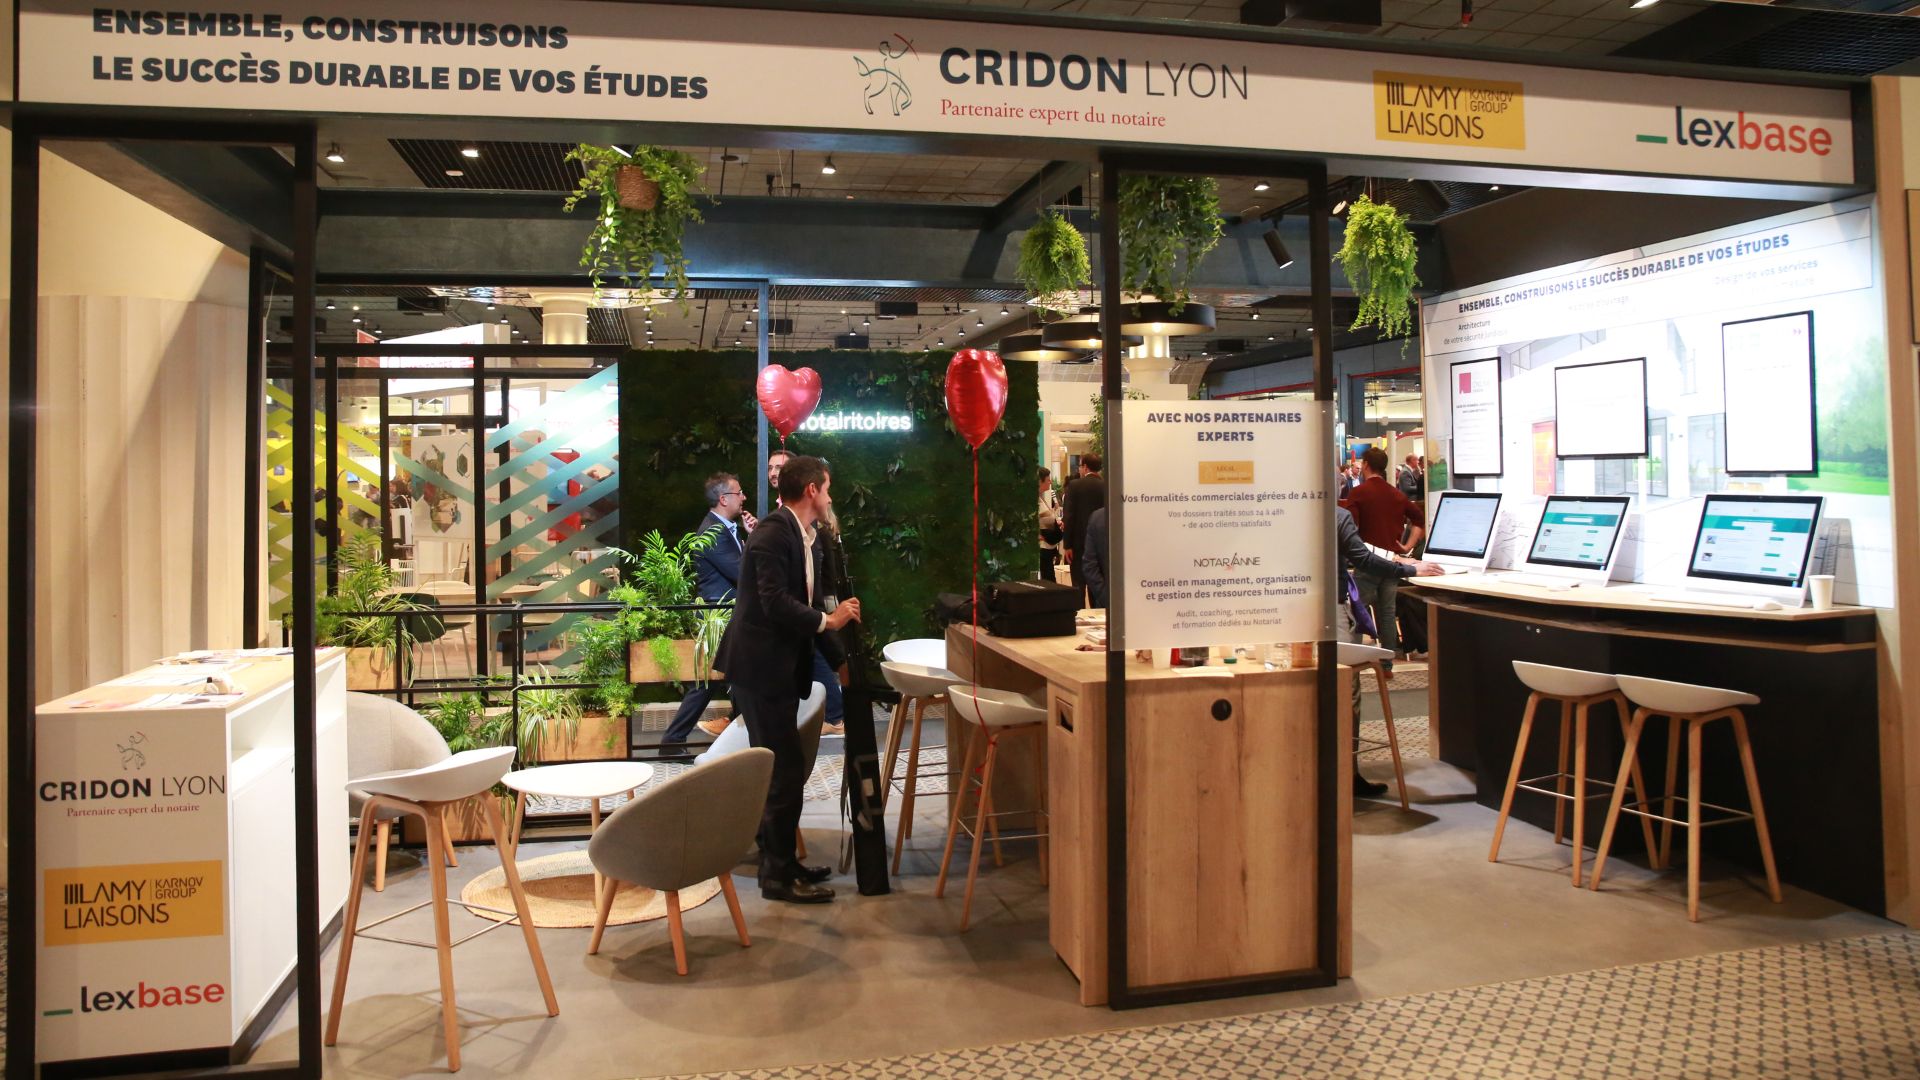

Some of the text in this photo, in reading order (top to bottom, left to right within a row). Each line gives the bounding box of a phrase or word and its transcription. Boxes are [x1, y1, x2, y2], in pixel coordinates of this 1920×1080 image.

[93, 8, 569, 49] ENSEMBLE, CONSTRUISONS
[93, 52, 709, 99] LE SUCCÈS DURABLE DE VOS ÉTUDES
[938, 47, 1249, 100] CRIDON LYON
[1469, 88, 1514, 102] KARNOV
[940, 99, 1166, 127] Partenaire expert du notaire
[1469, 101, 1508, 114] GROUP
[1387, 112, 1485, 140] LIAISONS
[1675, 105, 1833, 156] lexbase
[1458, 295, 1503, 314] ENSEMBLE,
[1504, 280, 1574, 304] CONSTRUISONS
[1576, 278, 1587, 289] LE
[1589, 266, 1630, 286] SUCCÈS
[1631, 256, 1685, 278] DURABLE
[1688, 252, 1704, 266] DE
[1707, 246, 1733, 262] VOS
[1735, 234, 1790, 256] ÉTUDES
[1778, 260, 1818, 274] services
[800, 411, 911, 431] otairitoires
[1147, 413, 1302, 423] AVEC NOS PARTENAIRES
[1197, 432, 1254, 442] EXPERTS
[1121, 494, 1138, 503] Vos
[1141, 493, 1189, 502] formalités
[1191, 492, 1255, 501] commerciales
[1257, 492, 1286, 503] gérées
[1288, 491, 1299, 500] de
[1301, 491, 1308, 499] A
[1168, 510, 1181, 518] Vos
[1183, 509, 1212, 518] dossiers
[1213, 508, 1237, 517] traités
[1238, 509, 1254, 517] sous
[1265, 508, 1270, 516] à
[1188, 521, 1198, 529] de
[1215, 520, 1239, 528] clients
[1240, 519, 1272, 527] satisfaits
[1140, 579, 1175, 588] Conseil
[1191, 577, 1253, 589] management,
[1256, 574, 1312, 586] organisation
[1146, 586, 1307, 602] et gestion des ressources humaines
[1176, 607, 1278, 620] Audit, coaching, recrutement
[1172, 622, 1180, 630] et
[1181, 620, 1217, 629] formation
[1218, 618, 1241, 628] dédiés
[1253, 617, 1282, 626] Notariat
[39, 775, 225, 802] CRIDON LYON
[66, 803, 200, 818] Partenaire expert du notaire
[155, 876, 203, 889] KARNOV
[155, 887, 197, 900] GROUP
[64, 903, 170, 929] LIAISONS
[80, 981, 225, 1013] lexbase
